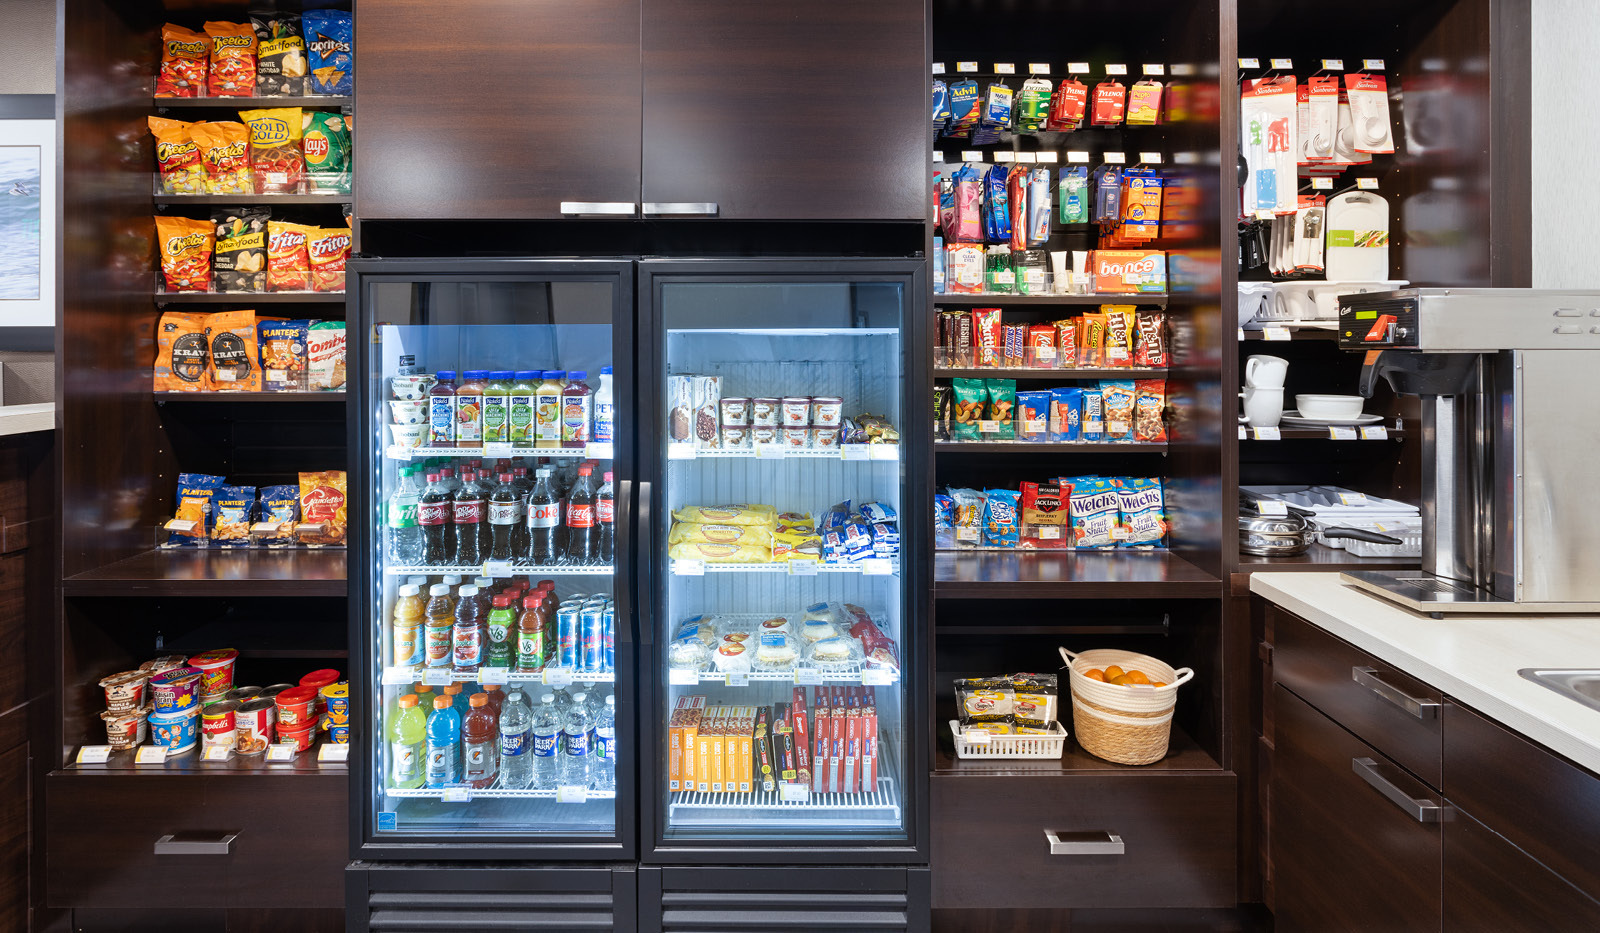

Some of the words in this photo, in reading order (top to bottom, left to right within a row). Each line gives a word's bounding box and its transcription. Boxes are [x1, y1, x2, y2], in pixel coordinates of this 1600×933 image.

[258, 39, 302, 55] Smartfood
[310, 41, 350, 53] Doritos
[952, 86, 976, 97] Advil
[1067, 87, 1085, 95] TYLENOL
[1255, 87, 1283, 95] Sunbeam
[1311, 86, 1336, 94] Sunbeam
[251, 123, 285, 132] ROLD
[157, 141, 199, 164] Cheeo
[304, 138, 327, 157] Lay's
[1132, 209, 1144, 217] Tide
[168, 233, 206, 256] Cheetos
[311, 236, 350, 257] Fritos
[1100, 260, 1154, 275] bounce
[263, 329, 300, 337] PLANTERS
[961, 318, 970, 354] HERSHEY'S
[980, 313, 996, 364] Skittles
[1005, 327, 1015, 358] SNICKERS
[1061, 327, 1076, 362] TWIX
[181, 488, 213, 496] PLANTERS
[1072, 494, 1117, 513] Welch's
[1121, 491, 1160, 509] Welch's
[388, 506, 418, 520] Sprit
[528, 506, 557, 519] Coke
[1091, 519, 1107, 528] Fruit
[1133, 521, 1158, 534] Snacks
[1086, 526, 1110, 537] Snack
[490, 627, 504, 640] V8
[522, 641, 532, 653] V8
[203, 719, 228, 731] ampbell's
[400, 747, 414, 765] G
[430, 749, 446, 767] G
[468, 747, 484, 764] G
